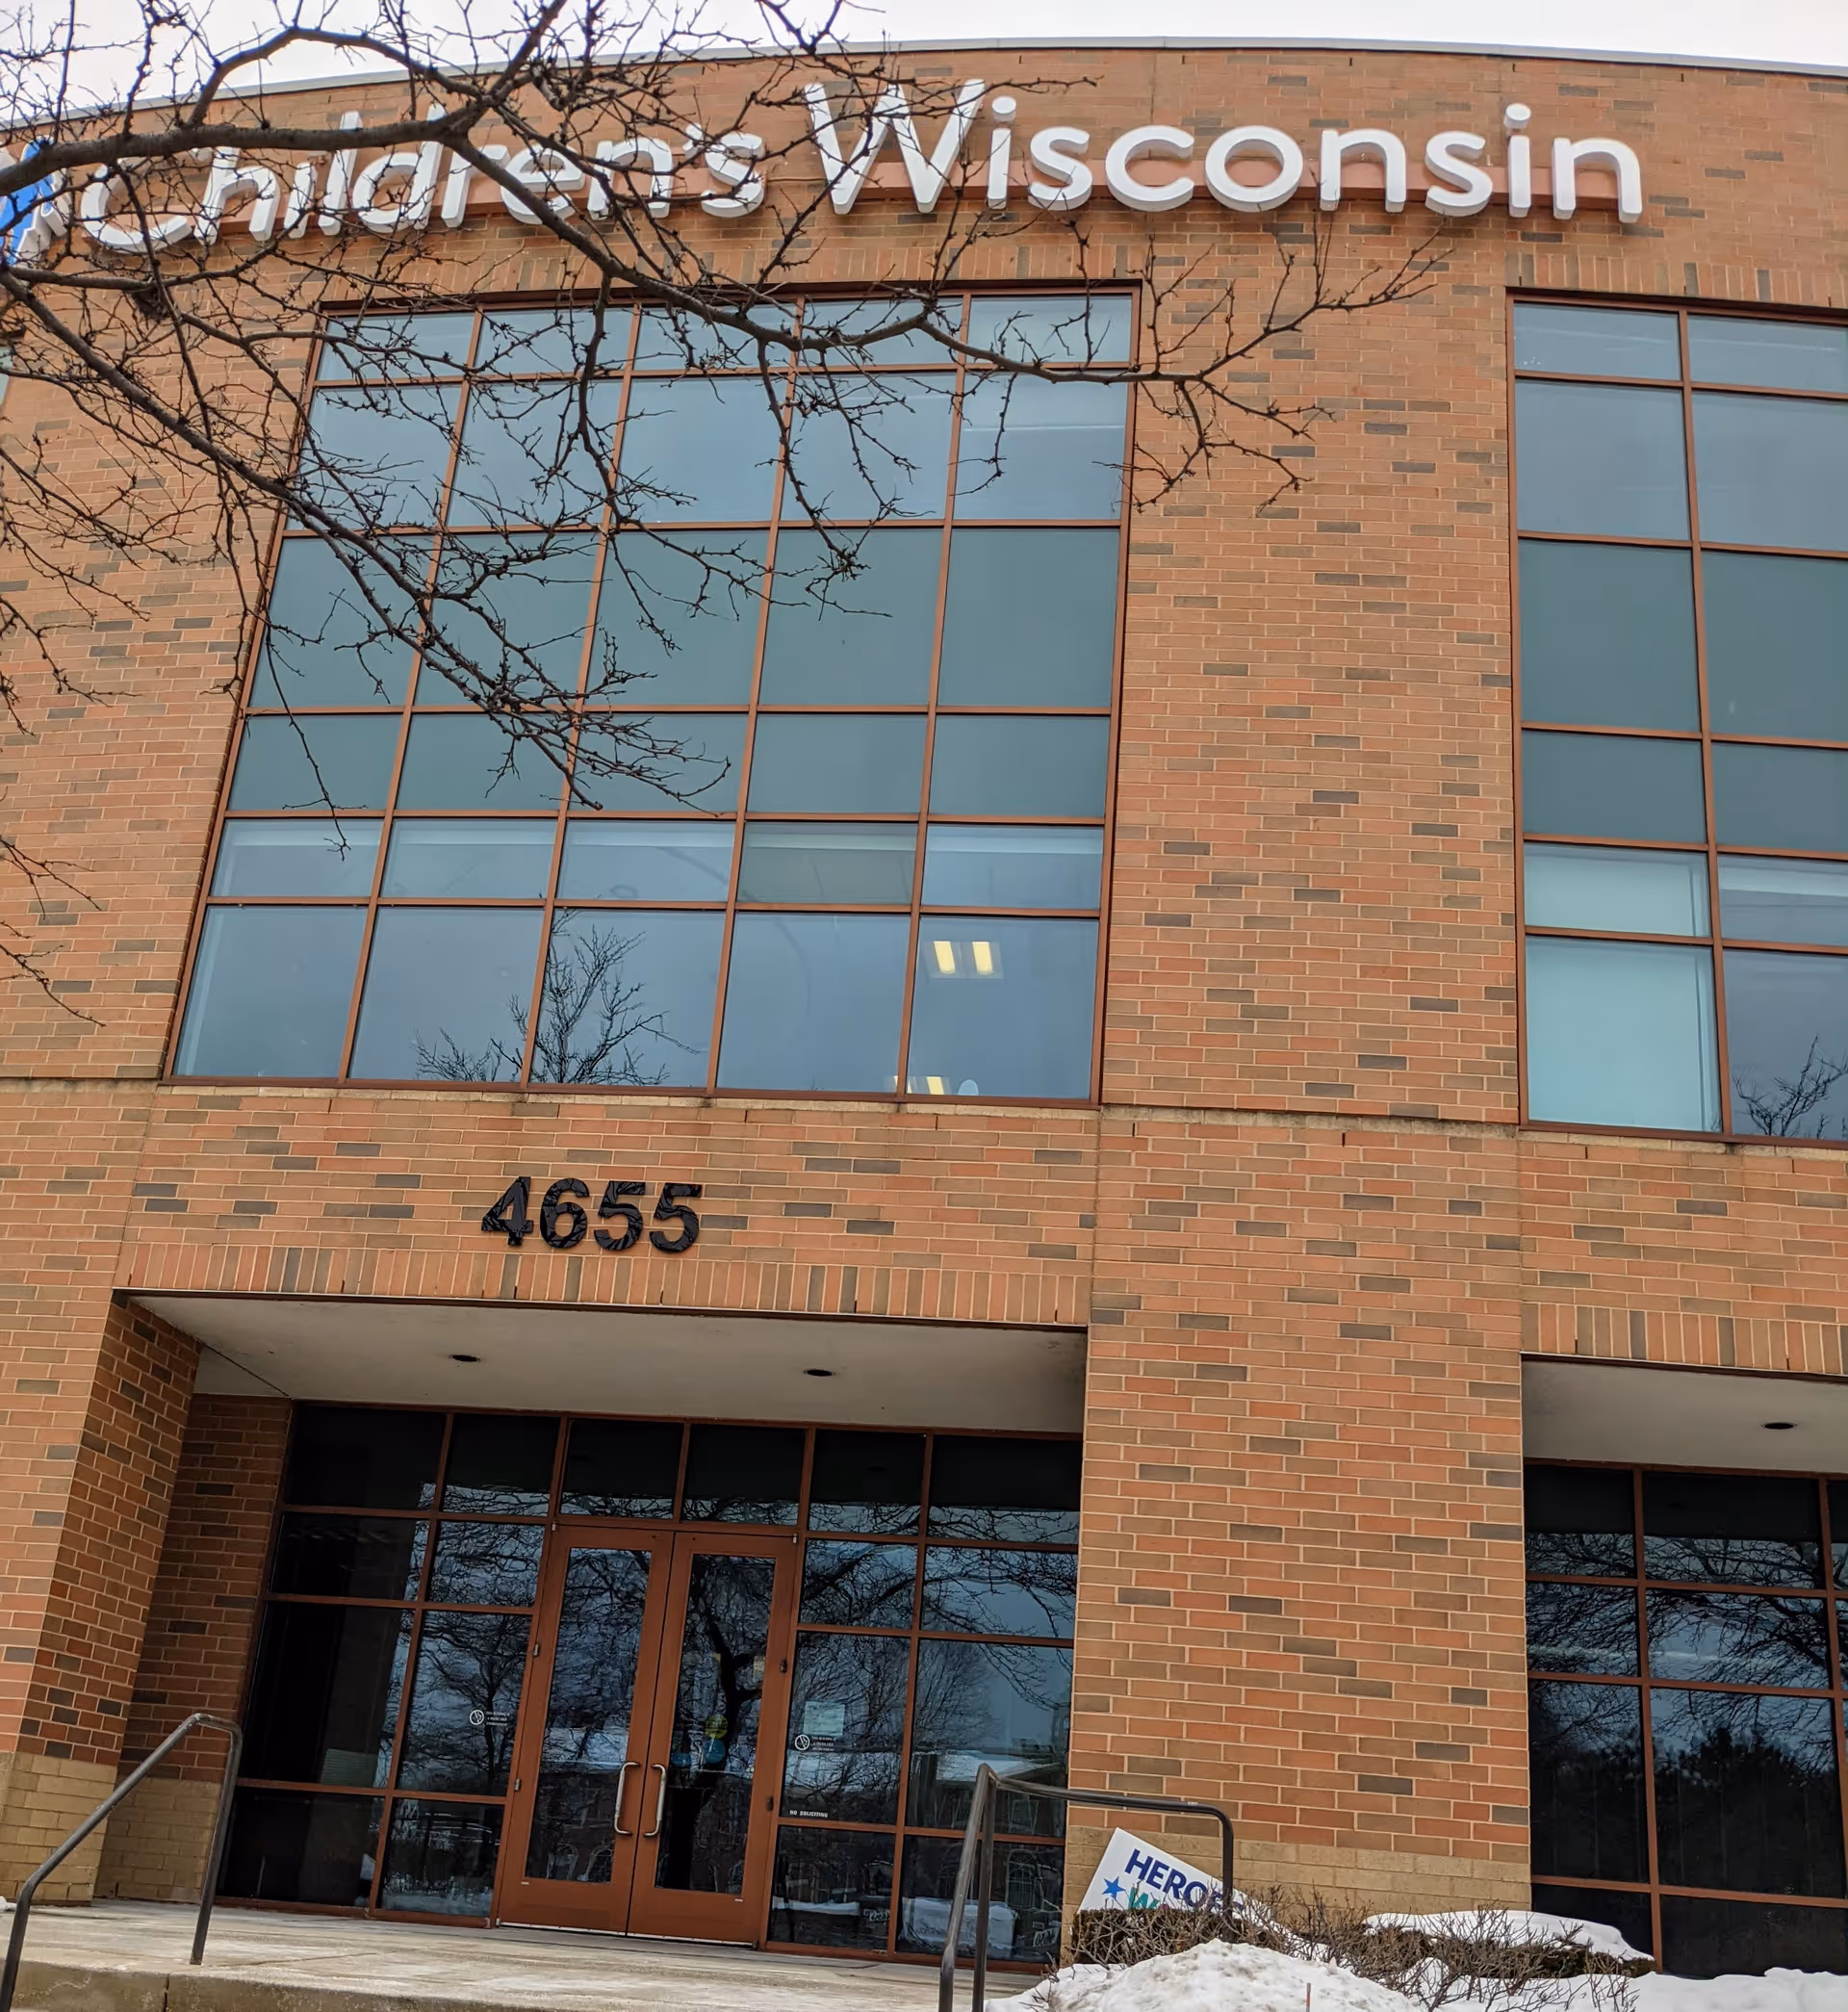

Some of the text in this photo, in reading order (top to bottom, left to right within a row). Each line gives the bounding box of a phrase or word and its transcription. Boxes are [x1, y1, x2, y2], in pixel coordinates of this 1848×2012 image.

[80, 78, 1644, 254] Children's Wisconsin
[480, 1175, 703, 1253] 4655
